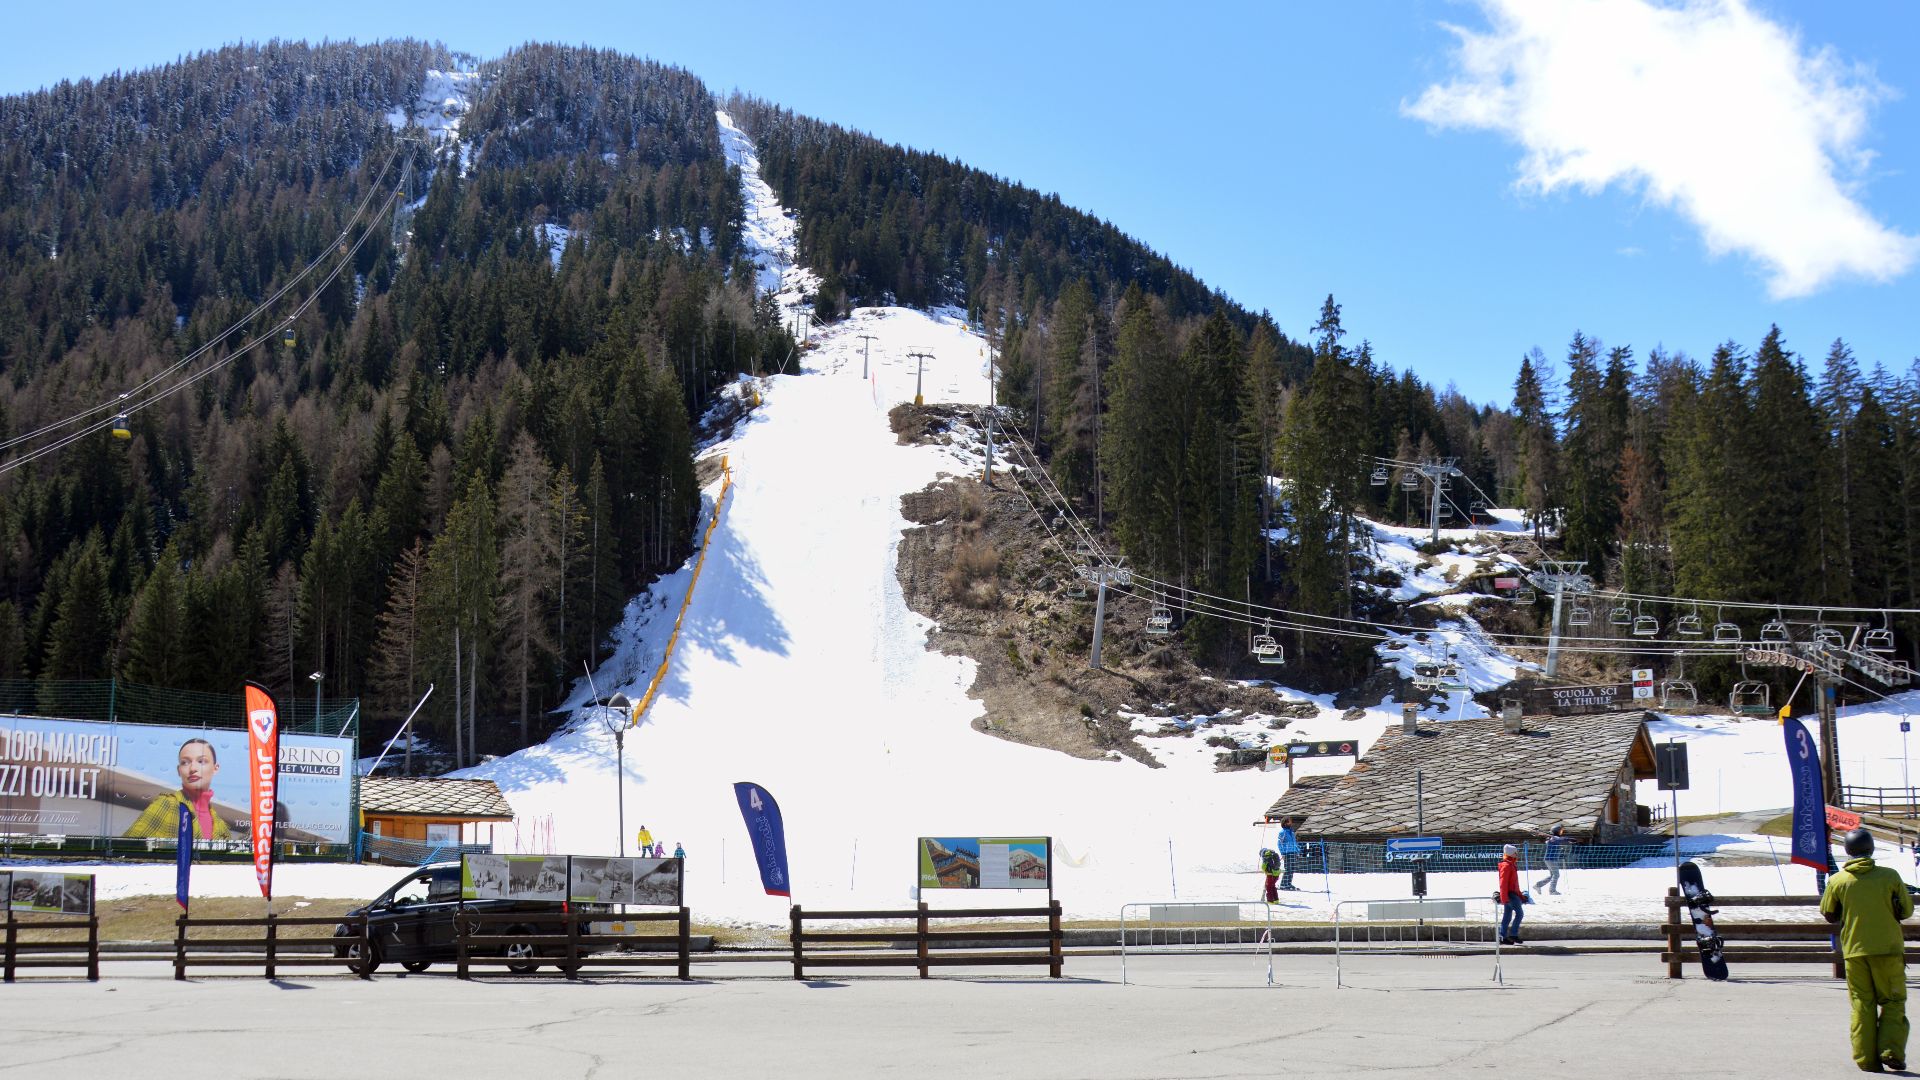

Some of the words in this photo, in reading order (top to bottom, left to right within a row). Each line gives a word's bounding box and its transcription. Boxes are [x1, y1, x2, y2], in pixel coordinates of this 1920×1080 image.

[1553, 687, 1595, 699] SCUOLA
[1600, 687, 1618, 696] SCI
[1558, 699, 1571, 707] LA
[1574, 696, 1612, 706] THUILE
[48, 731, 119, 767] MARCHI
[1796, 729, 1809, 759] 3
[279, 764, 297, 773] LET
[300, 765, 339, 775] VILLAGE
[0, 764, 28, 797] ZZI
[31, 766, 100, 800] OUTLET
[750, 787, 763, 811] 4
[182, 811, 189, 832] 5
